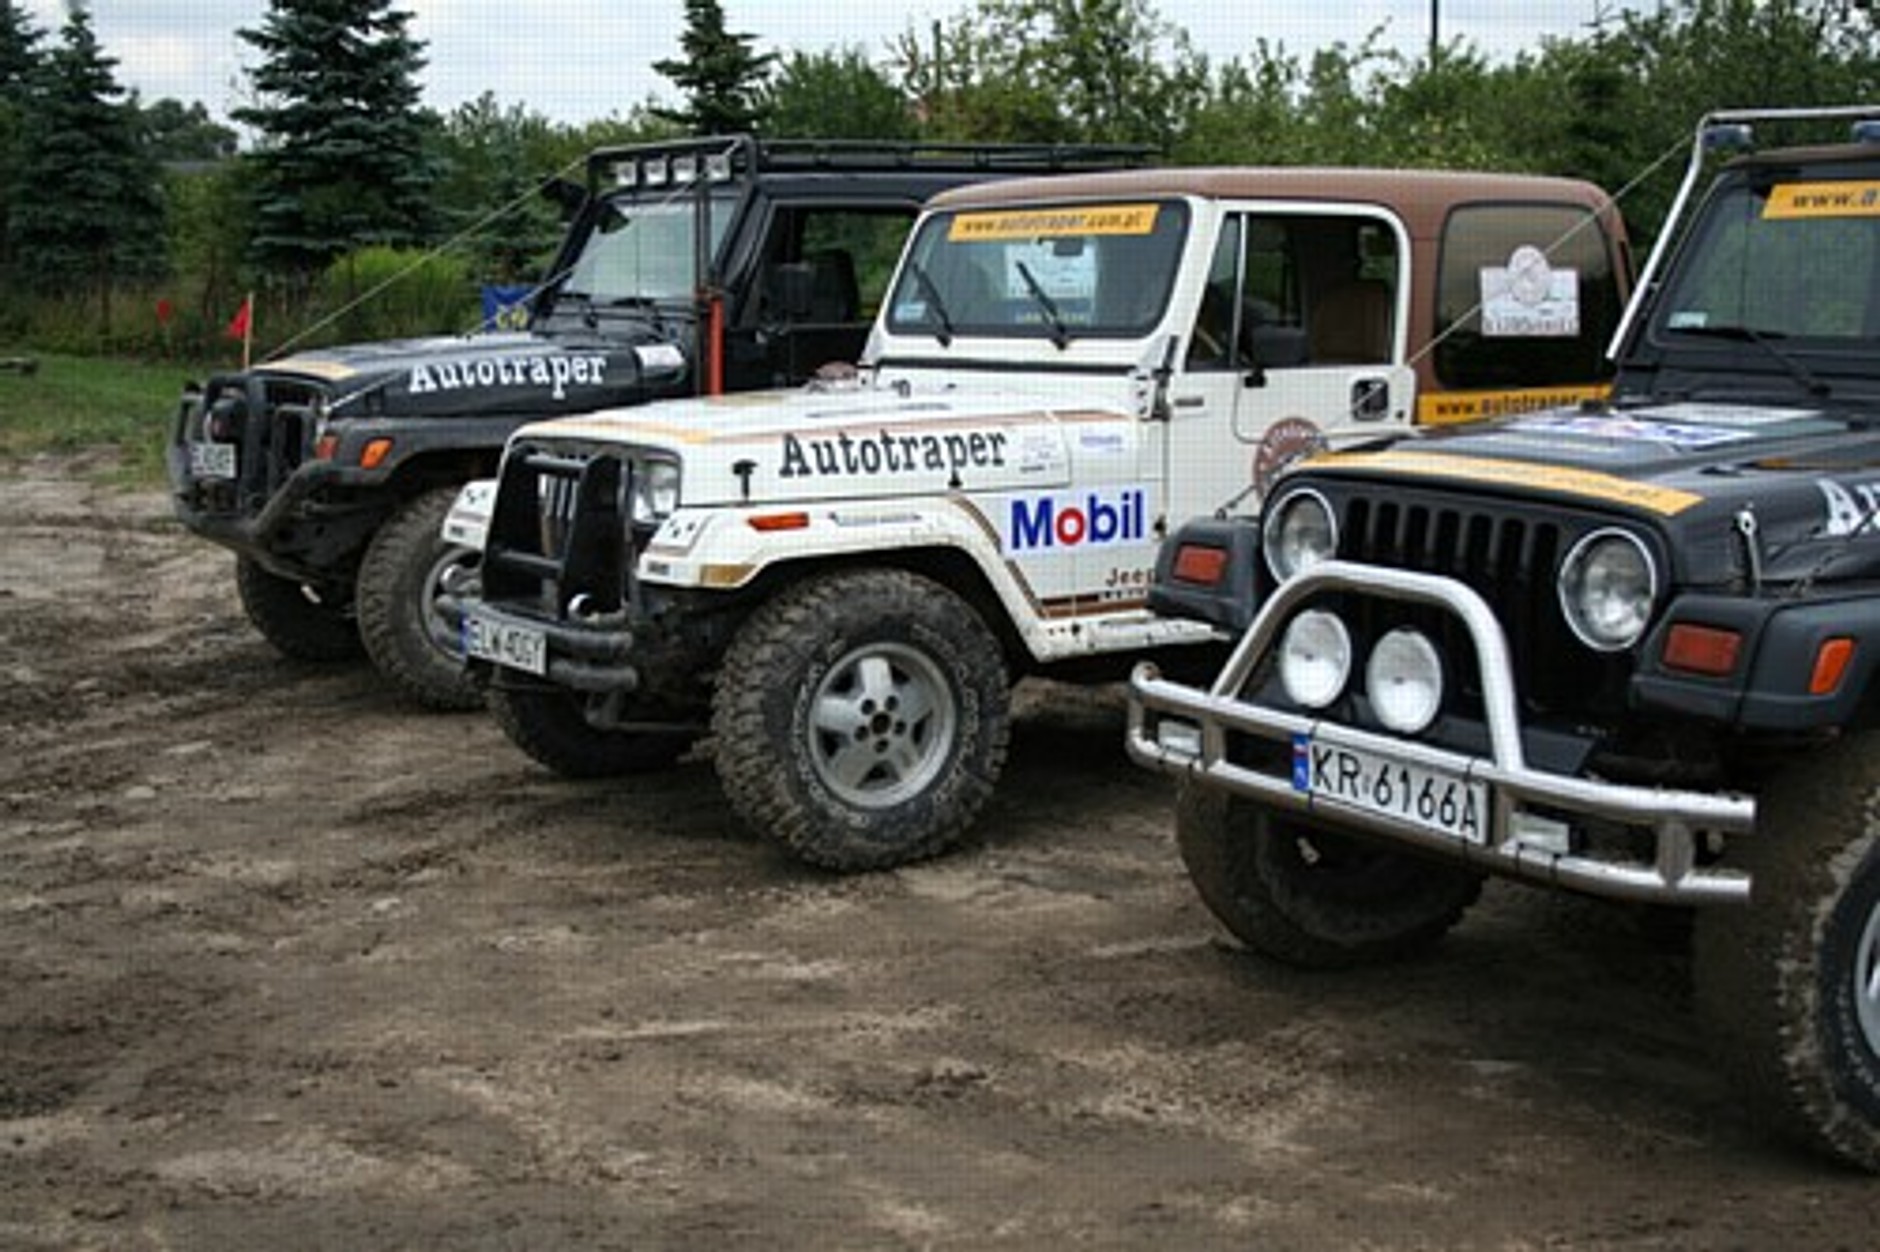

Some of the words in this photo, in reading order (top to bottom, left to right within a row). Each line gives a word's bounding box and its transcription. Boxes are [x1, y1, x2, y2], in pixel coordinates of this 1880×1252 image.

[409, 355, 606, 398] Autotraper
[779, 430, 1006, 484] Autotraper
[1010, 491, 1143, 550] Mobil
